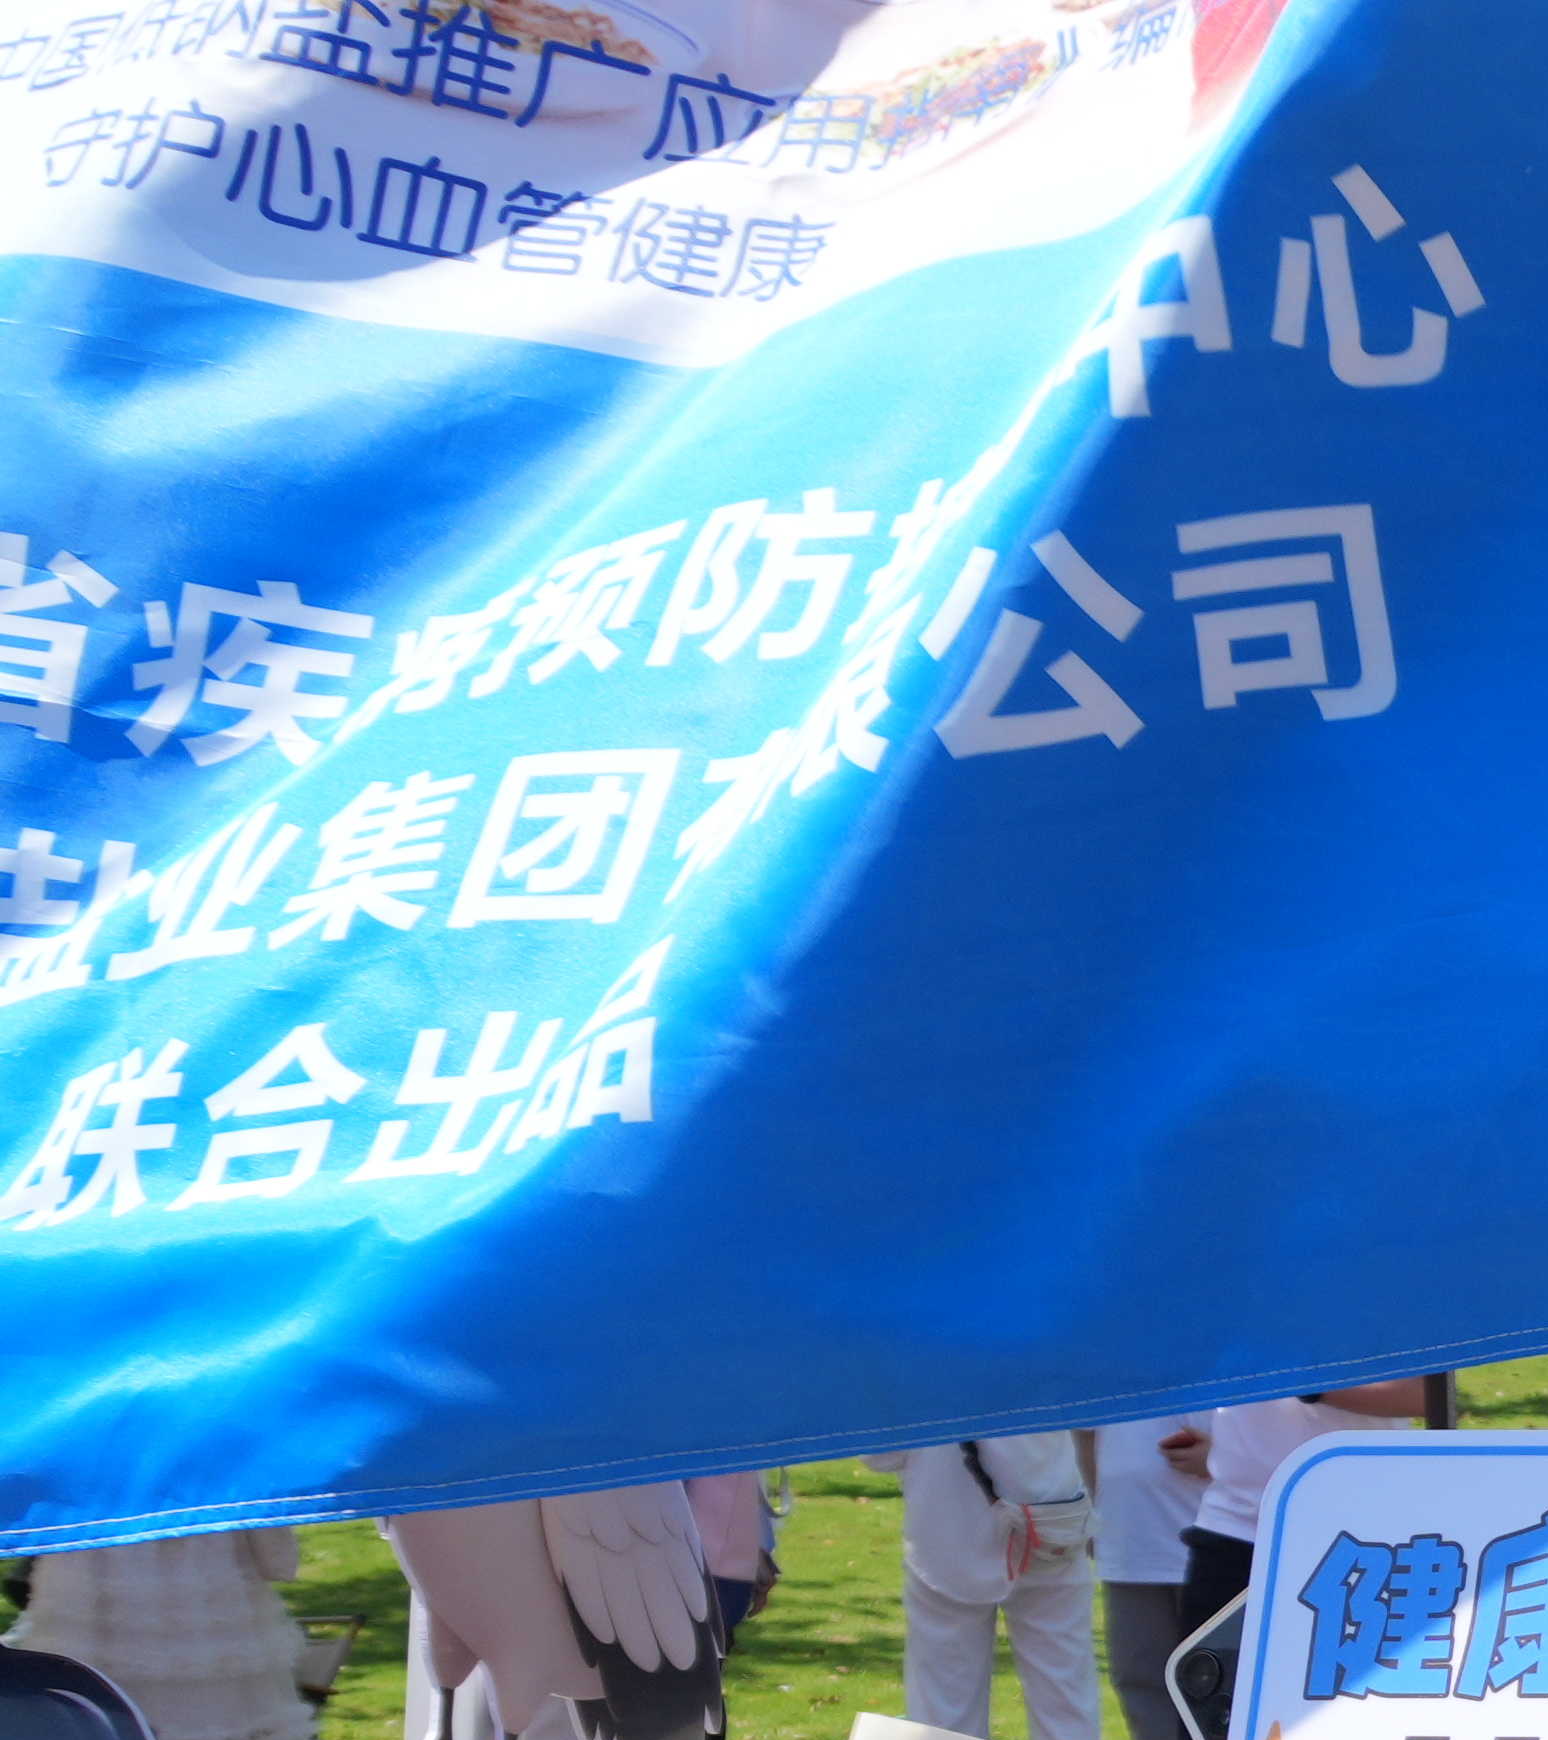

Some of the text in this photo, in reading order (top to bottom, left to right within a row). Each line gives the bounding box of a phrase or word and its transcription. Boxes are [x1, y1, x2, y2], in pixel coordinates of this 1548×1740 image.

[43, 98, 836, 301] 守护心血管健康
[2, 936, 674, 1231] 联合出品
